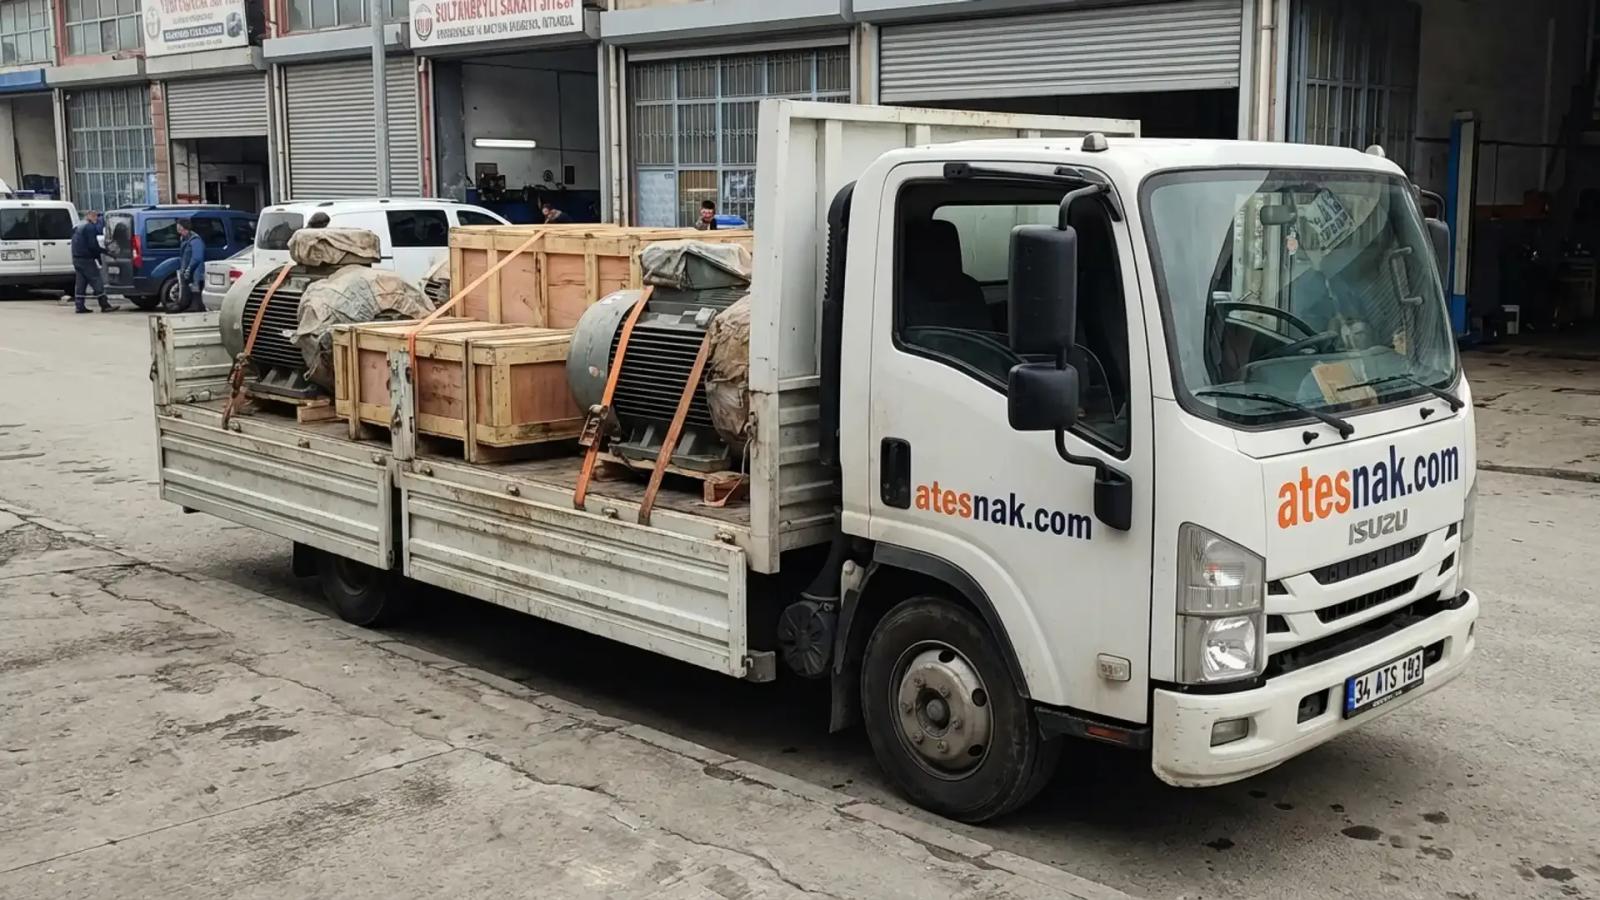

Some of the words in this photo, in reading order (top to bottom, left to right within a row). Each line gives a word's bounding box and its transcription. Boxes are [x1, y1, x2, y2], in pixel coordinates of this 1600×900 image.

[915, 480, 1092, 540] atesnak.com
[1277, 444, 1459, 529] atesnak.com
[1348, 508, 1408, 546] ISUZU
[1355, 676, 1371, 704] 34
[1375, 665, 1397, 695] ATS
